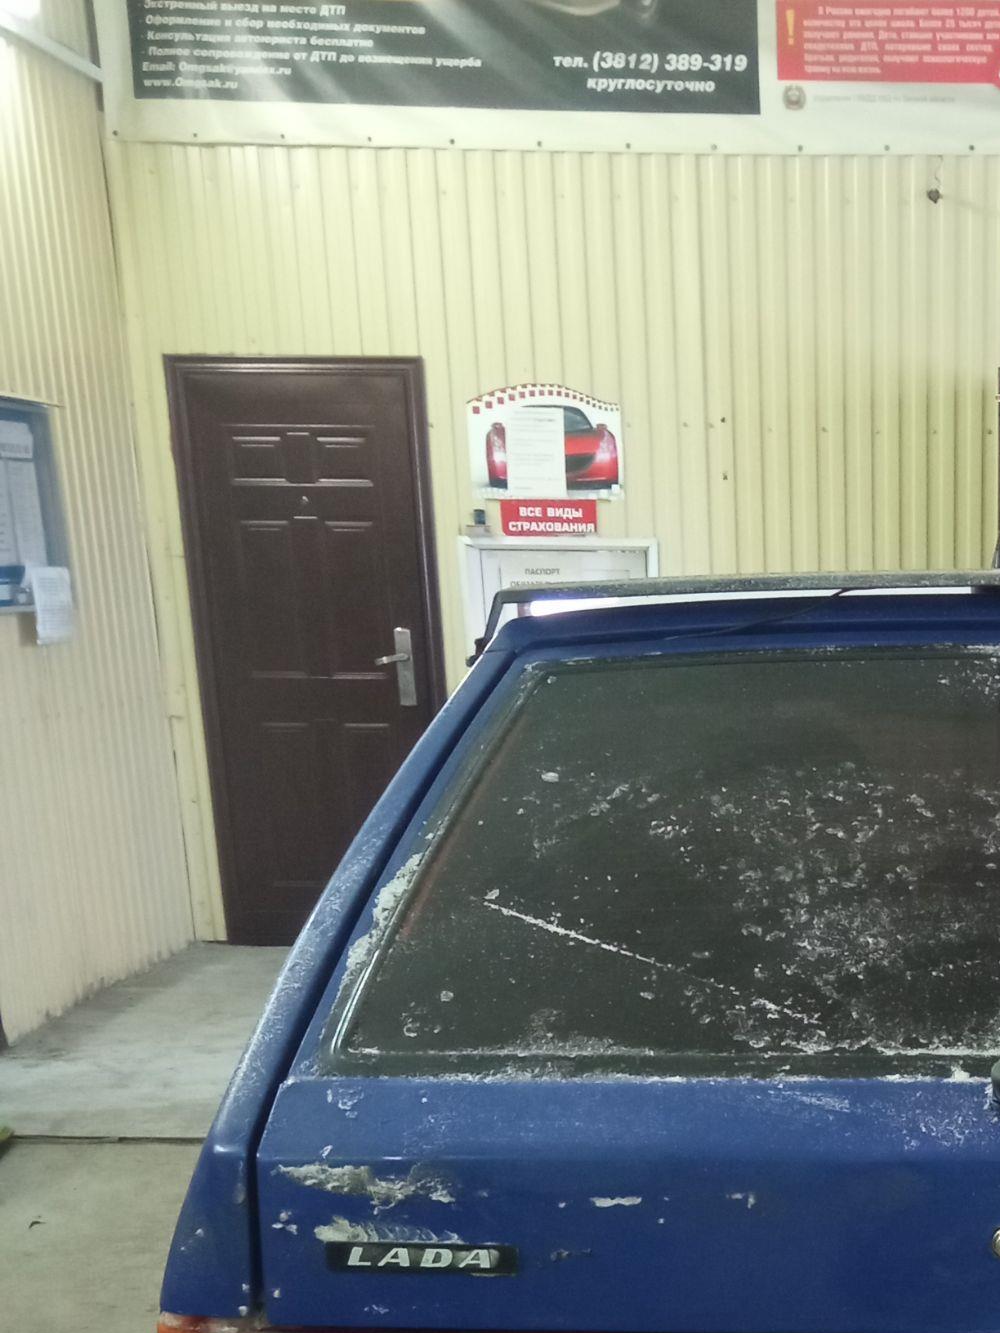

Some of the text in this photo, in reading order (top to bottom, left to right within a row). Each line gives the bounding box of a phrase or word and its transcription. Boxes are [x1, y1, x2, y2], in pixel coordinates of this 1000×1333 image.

[320, 5, 346, 16] ДТП
[310, 51, 337, 63] ДТП
[553, 51, 748, 73] тел. (3812) 389-319
[586, 77, 716, 94] круглосуточно
[518, 506, 583, 519] ВСЕ ВИДЫ
[508, 521, 596, 534] СТРАХОВАНИЯ
[347, 1246, 493, 1269] LADA
